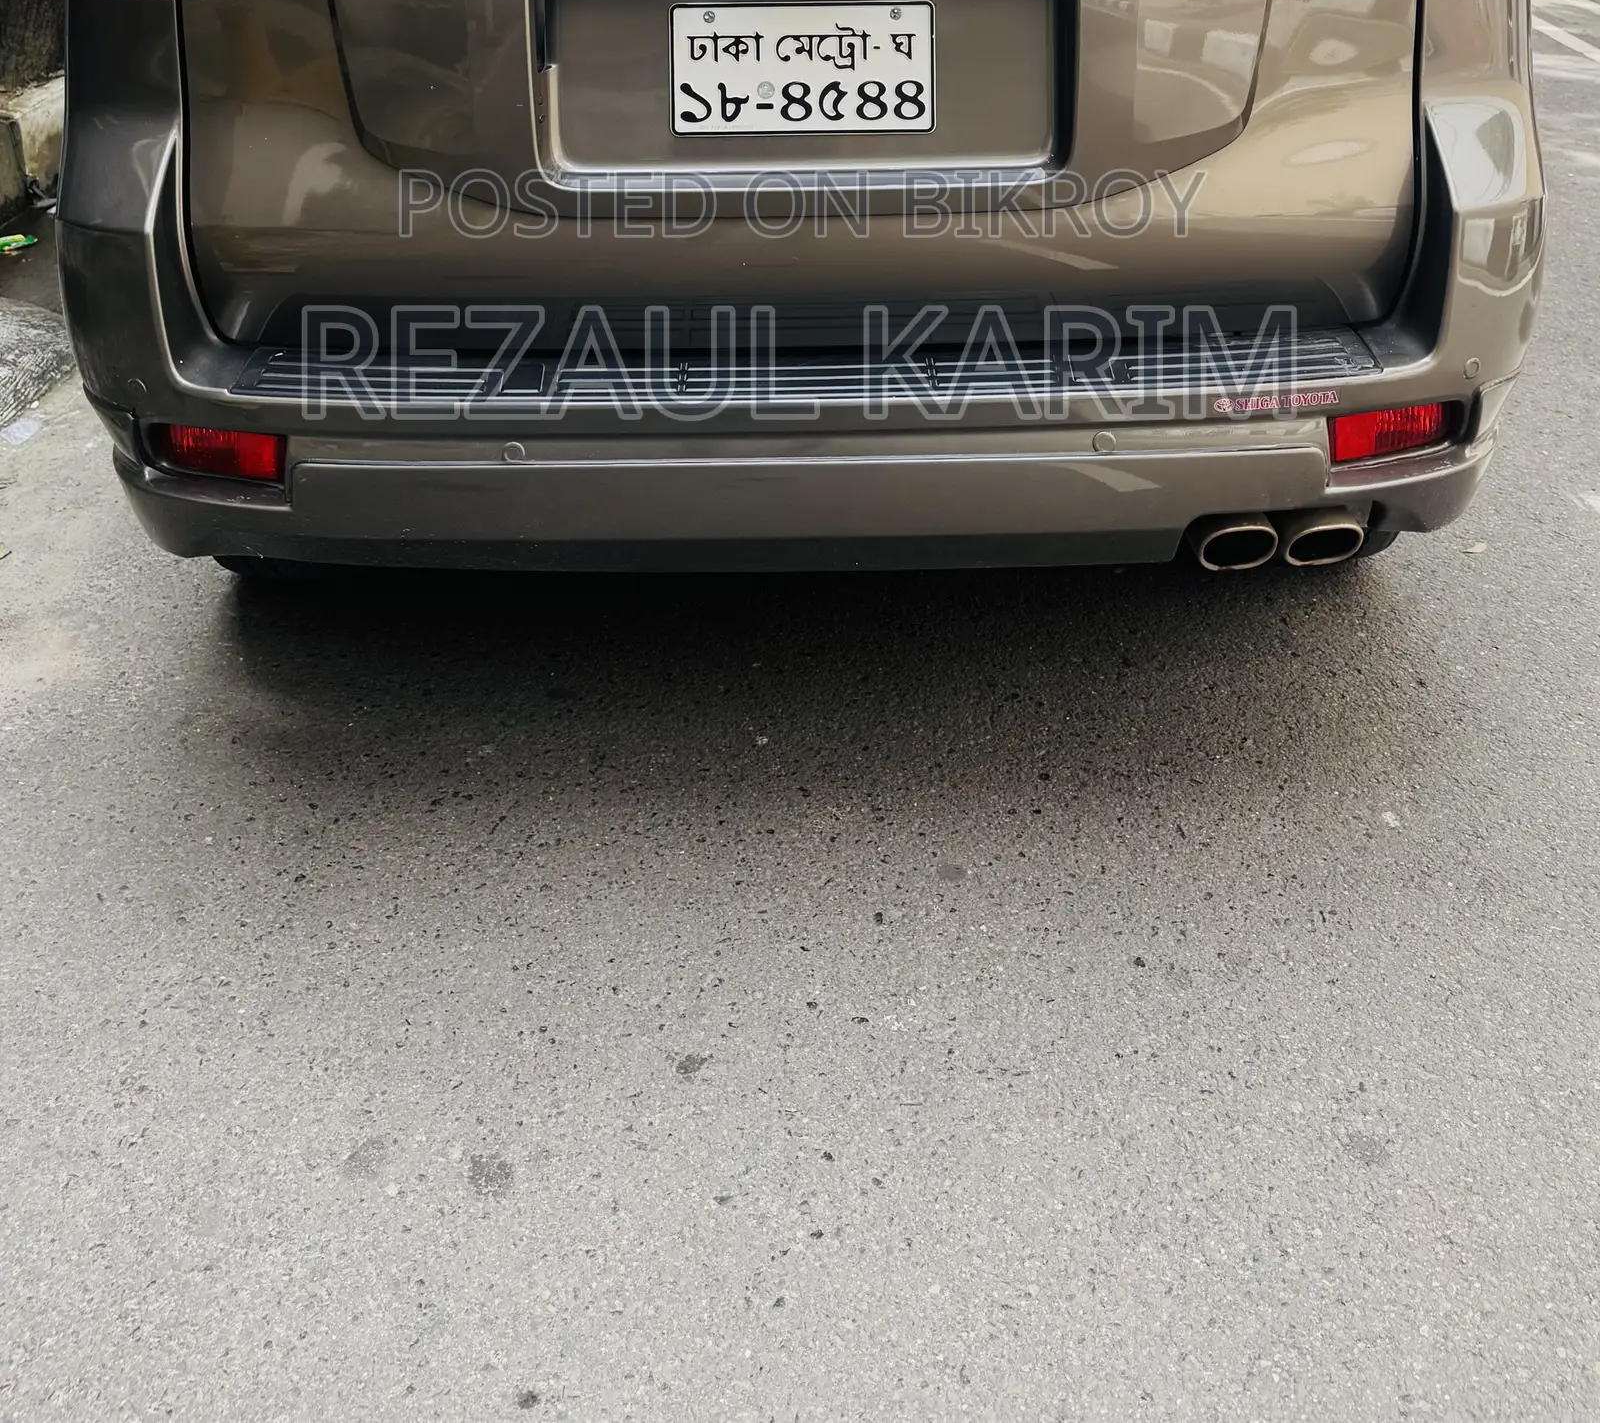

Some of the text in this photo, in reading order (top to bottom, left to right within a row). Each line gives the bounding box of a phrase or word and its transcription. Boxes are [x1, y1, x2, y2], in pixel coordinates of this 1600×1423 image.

[687, 31, 764, 62] ঢাকা
[890, 33, 916, 60] ঘ
[680, 80, 926, 122] ১৮-৪৫৪৪
[1235, 391, 1339, 411] SHIGA TOYOTA
